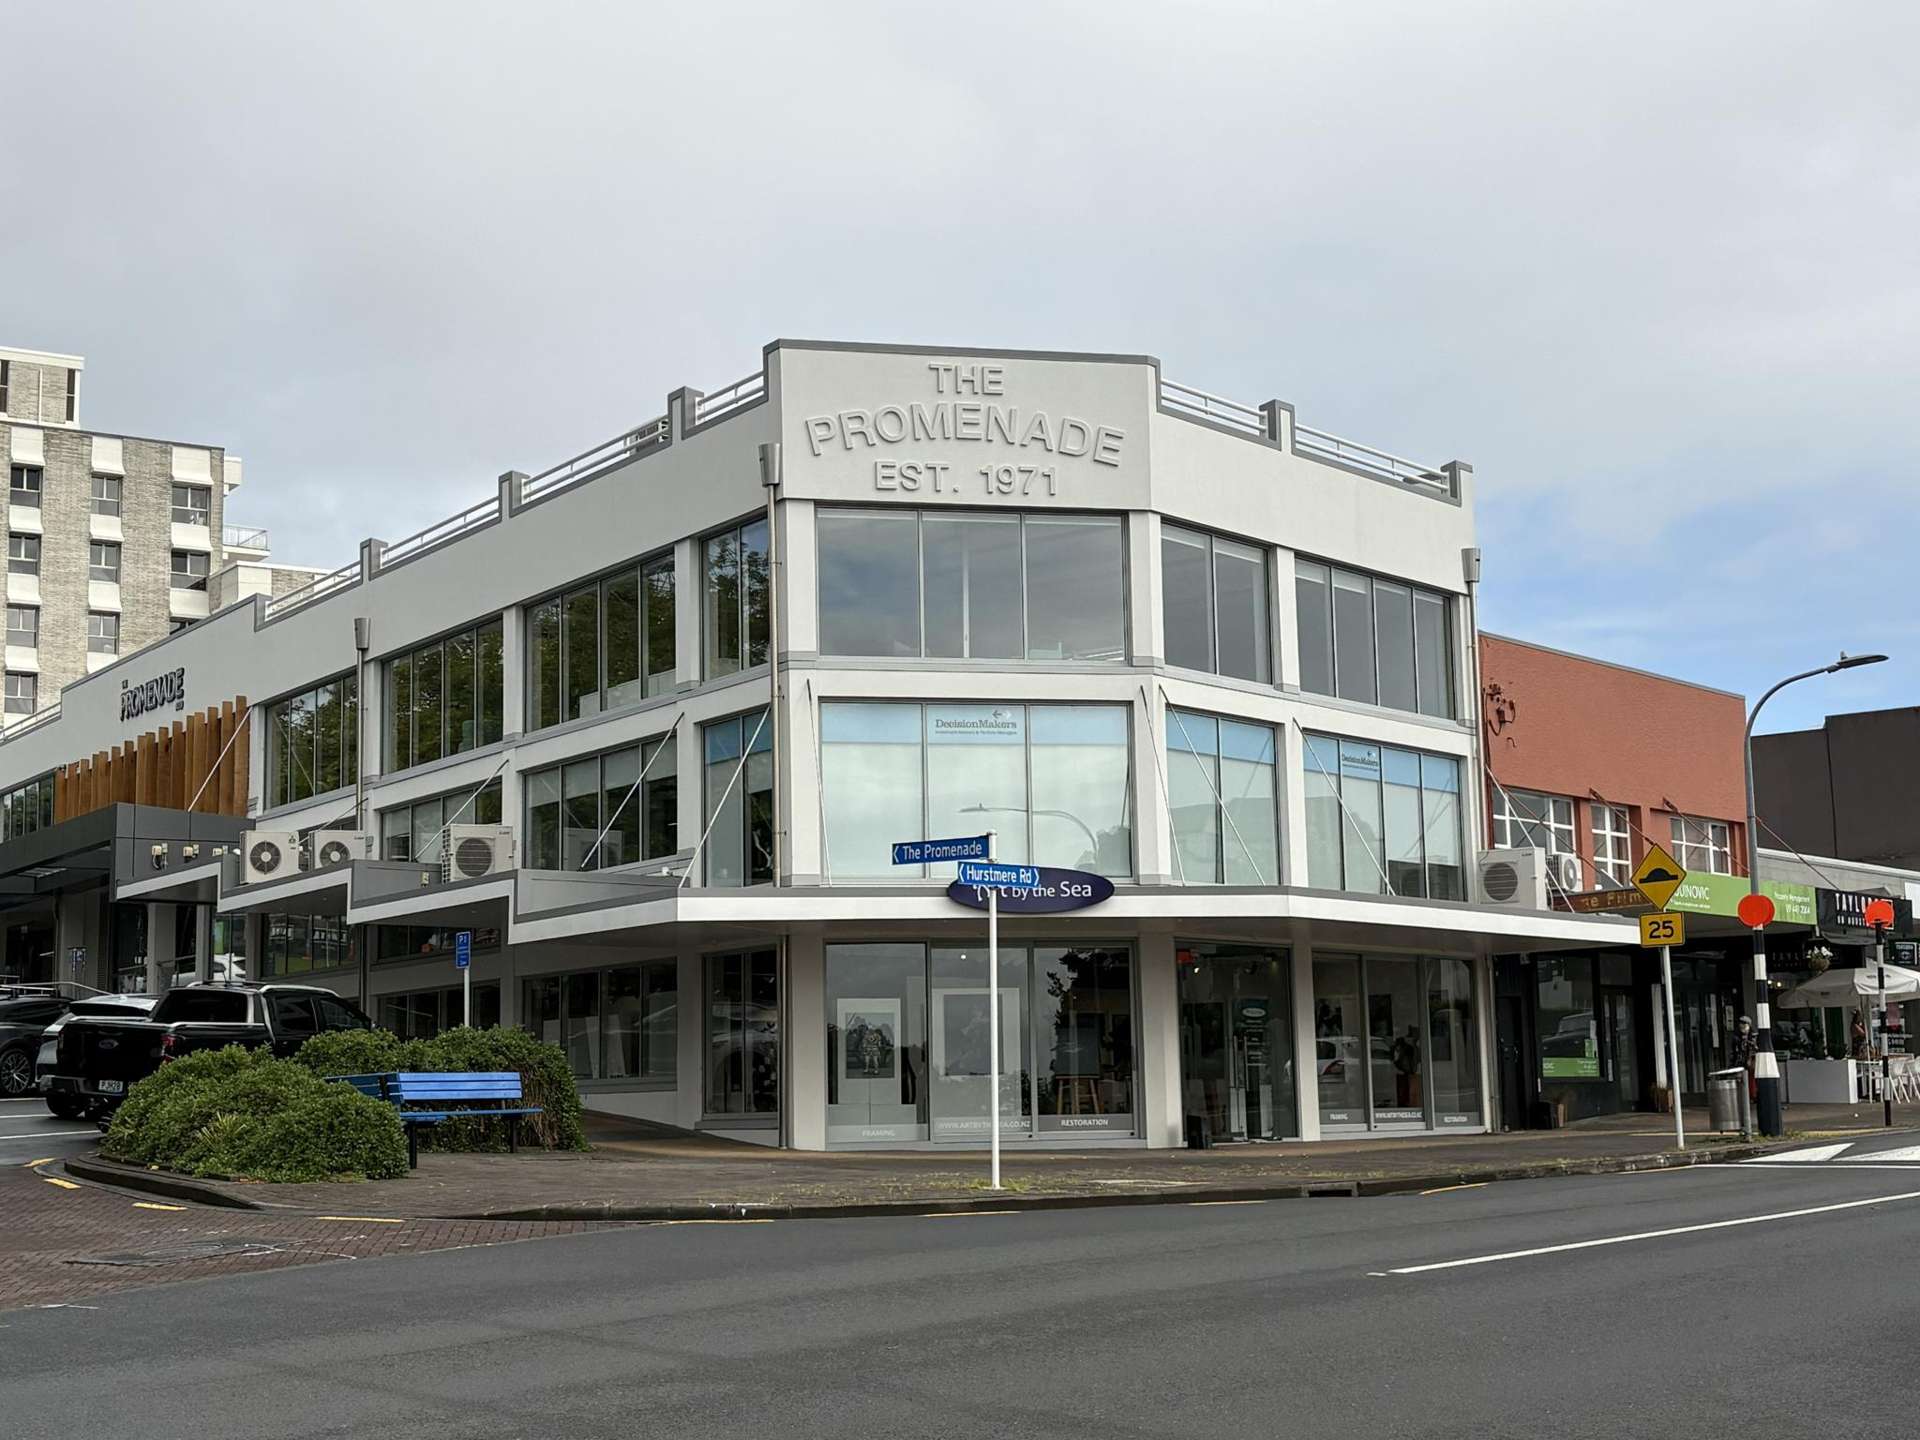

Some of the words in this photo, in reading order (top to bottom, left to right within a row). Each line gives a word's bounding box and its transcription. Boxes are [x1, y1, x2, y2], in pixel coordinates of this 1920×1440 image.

[928, 361, 1004, 395] THE
[805, 402, 1126, 467] PROMENADE
[874, 459, 960, 493] EST.
[979, 464, 1057, 496] 1971
[903, 845, 921, 860] The
[924, 841, 982, 858] Promenade
[967, 868, 1017, 884] Hurstmere
[1019, 869, 1031, 883] Rd
[1060, 881, 1092, 897] Sea
[1648, 920, 1674, 939] 25
[1061, 1119, 1108, 1127] RESTORATION
